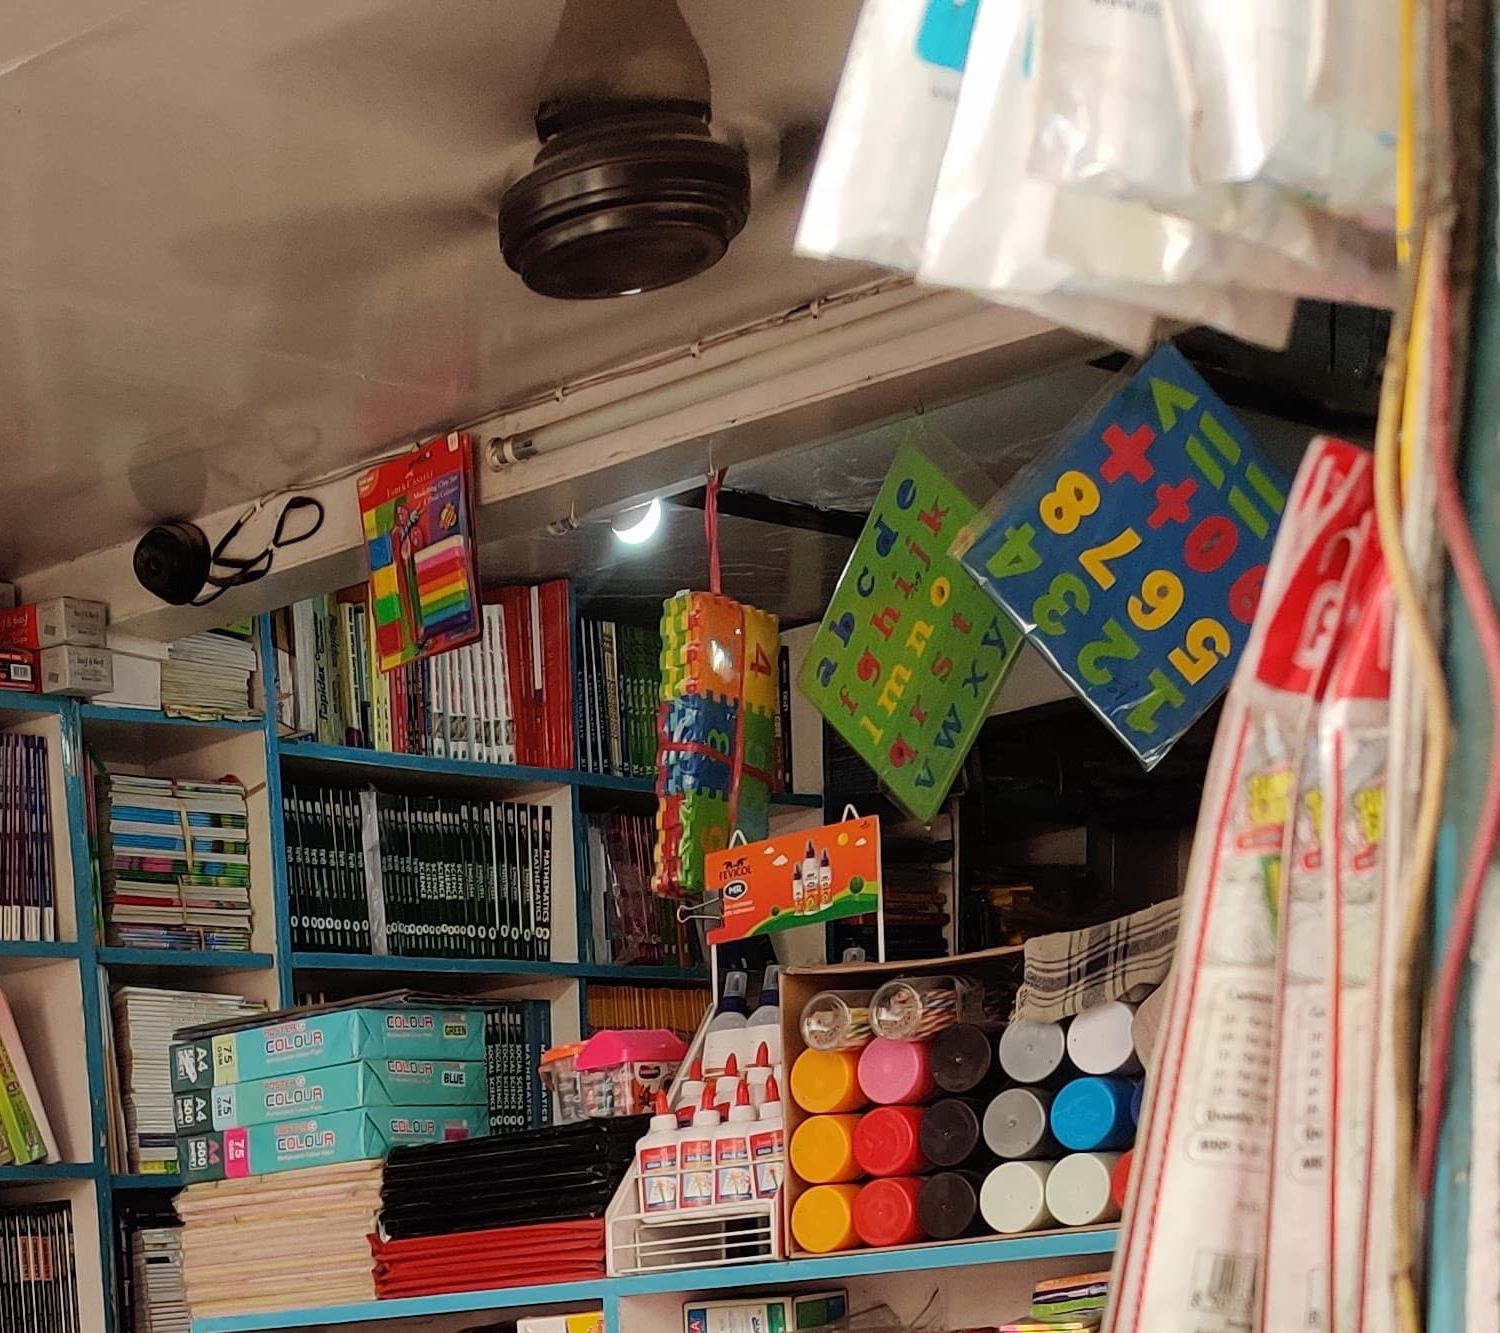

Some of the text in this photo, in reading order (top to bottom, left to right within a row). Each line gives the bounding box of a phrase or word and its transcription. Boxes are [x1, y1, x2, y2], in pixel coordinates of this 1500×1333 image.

[917, 494, 950, 537] k
[905, 538, 932, 572] j
[816, 477, 917, 687] a b c d e
[1039, 470, 1231, 686] 5 6 7 8
[870, 606, 900, 642] h
[985, 522, 1185, 734] 1 2 3 4
[877, 664, 912, 718] m
[905, 618, 935, 657] n
[929, 576, 951, 607] o
[856, 649, 882, 687] g
[889, 609, 974, 768] q r s t
[840, 687, 859, 718] f
[915, 758, 936, 790] v
[933, 704, 964, 752] w
[962, 659, 990, 697] x
[719, 865, 752, 880] FEVICOL
[387, 1015, 433, 1030] COLOUR
[444, 1025, 467, 1037] GREEN
[223, 1045, 233, 1064] 75
[266, 1030, 324, 1055] COLOUR
[196, 1047, 208, 1072] A4
[444, 1072, 464, 1085] BLUE
[195, 1097, 207, 1122] A4
[223, 1095, 232, 1116] 75
[266, 1087, 323, 1109] COLOUR
[184, 1103, 193, 1125] 500
[197, 1142, 206, 1165] 500
[235, 1139, 246, 1159] 75
